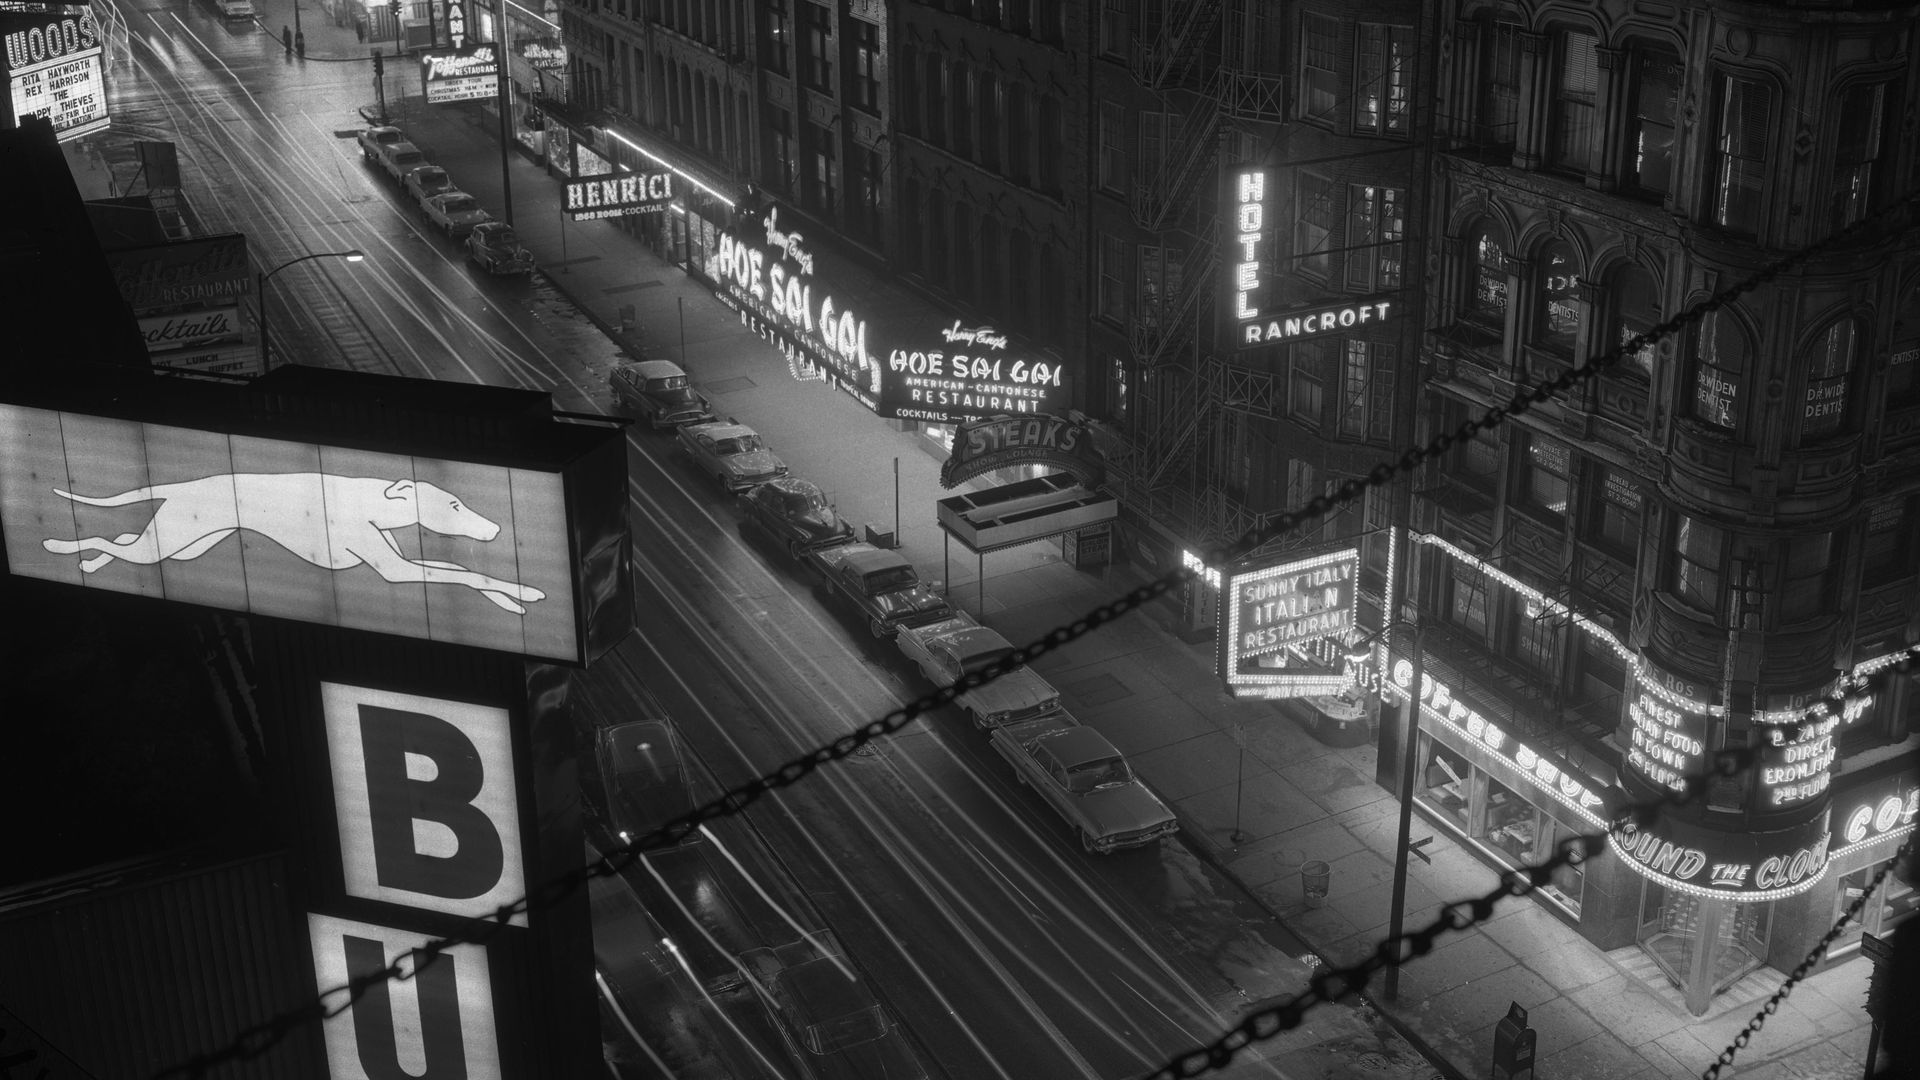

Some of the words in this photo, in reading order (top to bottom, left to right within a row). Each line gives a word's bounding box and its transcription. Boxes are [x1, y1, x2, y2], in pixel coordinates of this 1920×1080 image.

[448, 0, 465, 49] ANT
[5, 15, 95, 69] WOODS
[22, 73, 41, 87] RITA
[48, 59, 91, 79] HAYWORTH
[25, 85, 43, 98] REX
[49, 71, 90, 91] HARRISON
[66, 109, 80, 119] FAIR
[82, 104, 97, 114] LADY
[567, 173, 672, 208] HENRICI
[596, 209, 622, 219] ROOM
[624, 204, 664, 215] COCKTAIL
[1239, 172, 1264, 319] HOTEL
[163, 278, 248, 302] RESTAURANT
[719, 232, 764, 301] HOE
[769, 262, 812, 334] SAI
[819, 295, 869, 371] GAI
[143, 313, 231, 343] cktails
[729, 284, 776, 325] AMERICAN
[794, 329, 856, 382] CANTONESE
[184, 354, 218, 365] LUNCH
[740, 310, 837, 391] RESTAURANT
[889, 349, 943, 375] HOE
[951, 355, 1002, 381] SAI
[1009, 360, 1062, 387] GAI
[896, 408, 947, 421] COCKTAILS
[912, 388, 1039, 412] RESTAURANT
[1697, 387, 1731, 411] DENTIST
[967, 420, 1081, 455] STEAKS
[1604, 479, 1641, 503] INVESTIGATION
[1608, 472, 1628, 488] BUREAU
[1244, 576, 1298, 604] SUNNY
[1305, 564, 1351, 589] ITALY
[1245, 609, 1350, 649] RESTAURANT
[1263, 685, 1291, 699] MAIN
[1291, 684, 1338, 697] ENTRANCE
[1393, 658, 1506, 750] COFFEE
[1639, 694, 1682, 729] FINEST
[1631, 727, 1643, 747] IN
[1644, 737, 1687, 771] TOWN
[1663, 729, 1703, 757] FOOD
[1784, 735, 1833, 763] DIRECT
[1515, 742, 1604, 809] SHOP
[1643, 761, 1688, 793] FLOOR
[1611, 822, 1706, 881] OUND
[1710, 864, 1752, 886] THE
